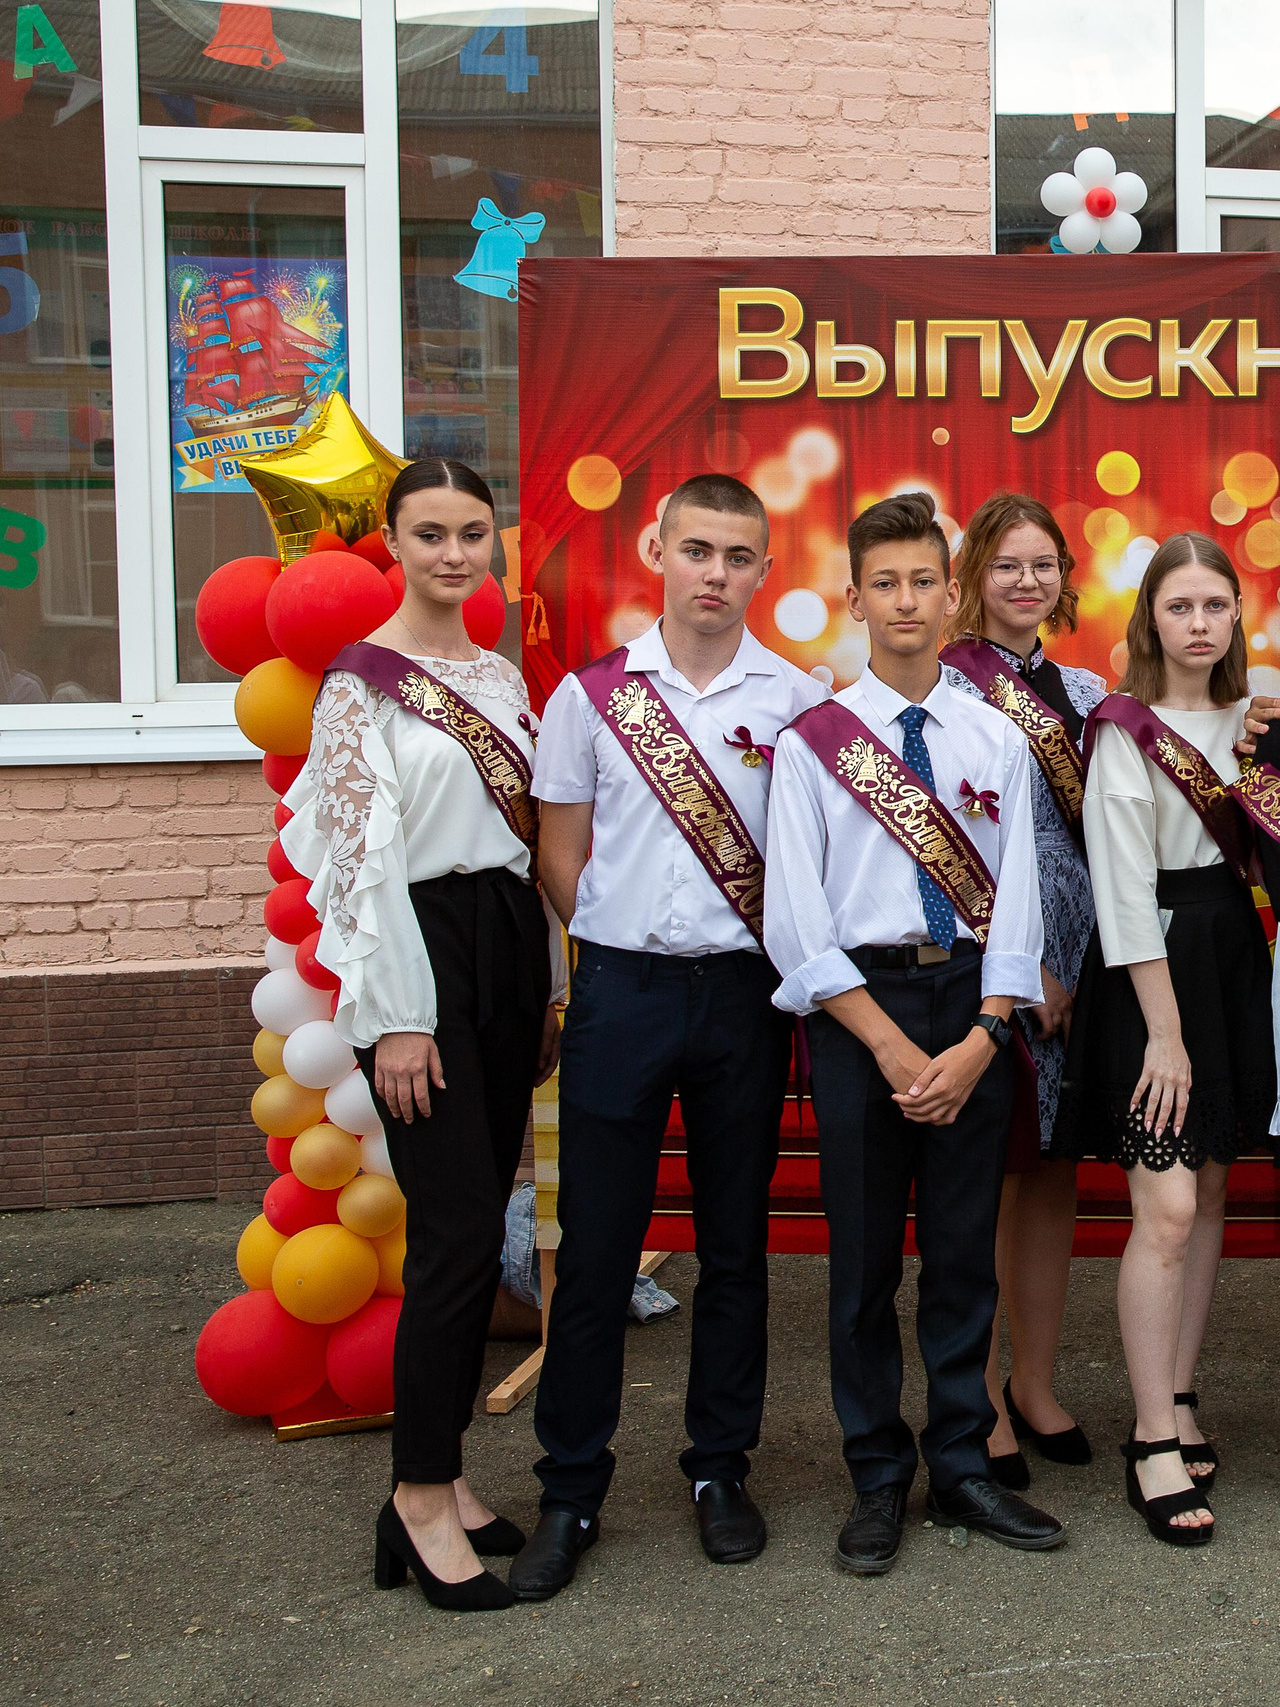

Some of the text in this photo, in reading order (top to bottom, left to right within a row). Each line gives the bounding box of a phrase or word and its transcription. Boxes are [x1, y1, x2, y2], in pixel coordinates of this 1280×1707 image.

[460, 7, 539, 93] 4
[184, 428, 298, 459] УДАЧИ ТЕБЕ
[640, 732, 765, 941] Выпускник 20
[878, 784, 990, 918] Выпускник
